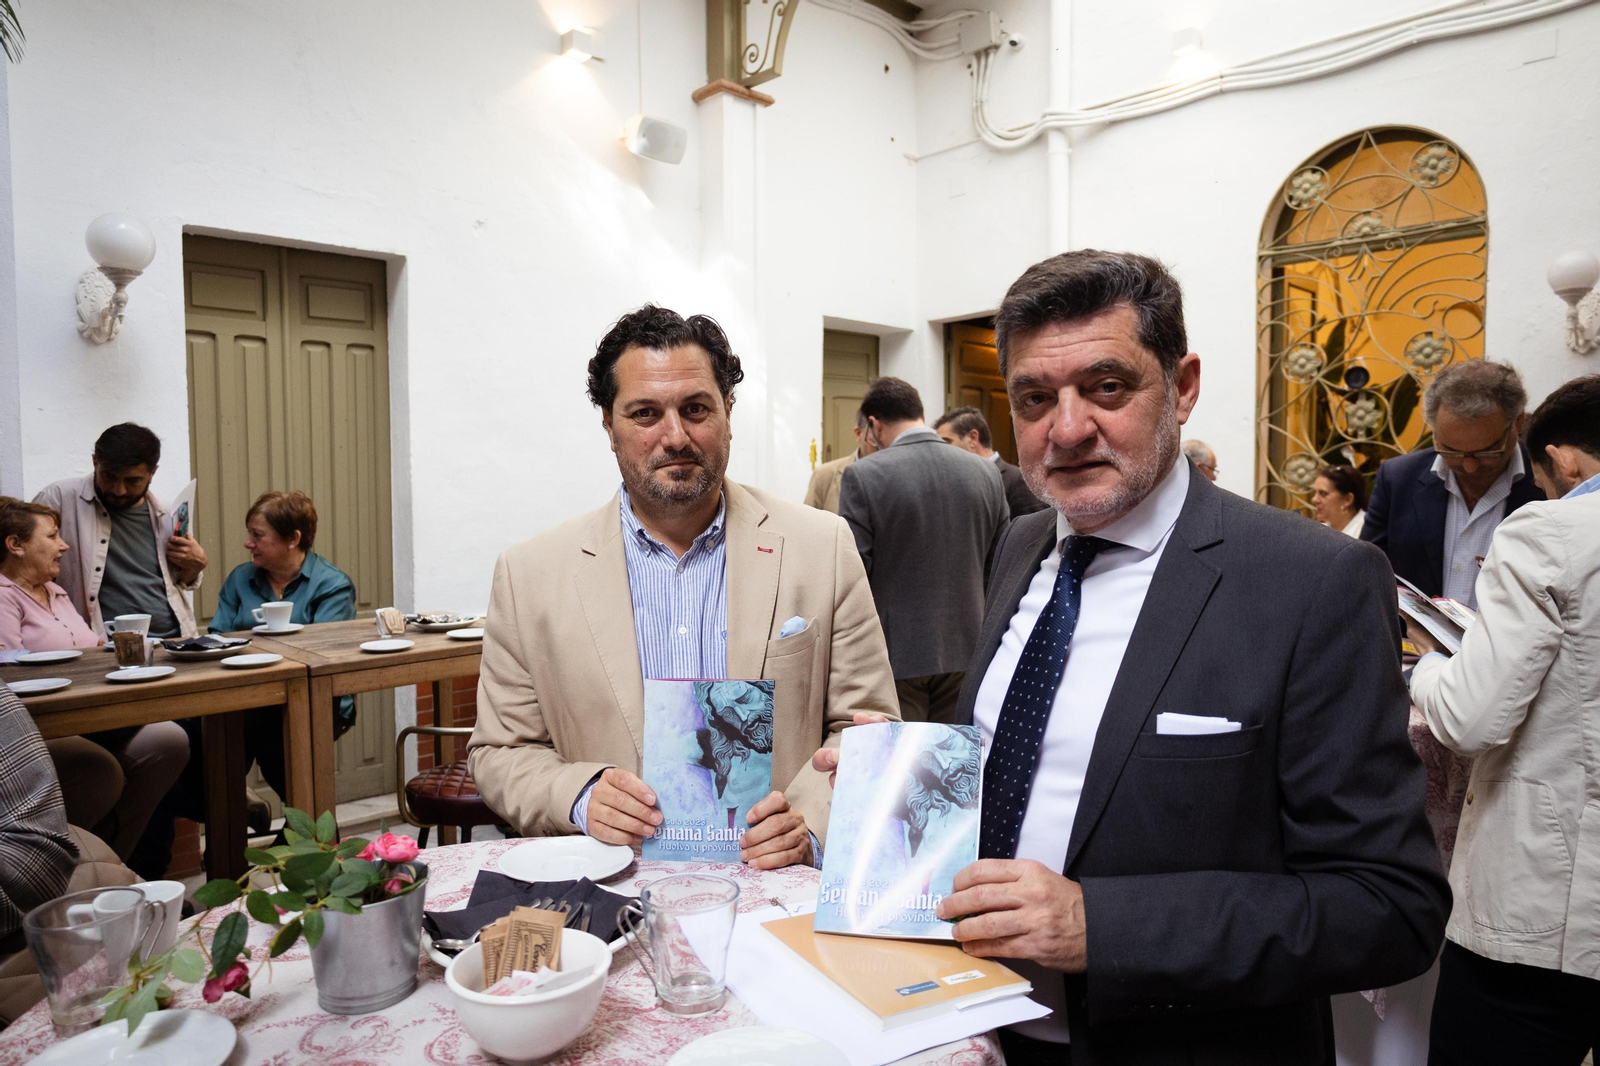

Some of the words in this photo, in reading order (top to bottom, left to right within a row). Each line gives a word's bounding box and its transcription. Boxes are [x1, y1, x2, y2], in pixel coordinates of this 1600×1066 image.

[683, 818, 706, 826] 2023
[647, 824, 703, 841] emana
[659, 841, 690, 851] Huelva
[692, 843, 699, 853] y
